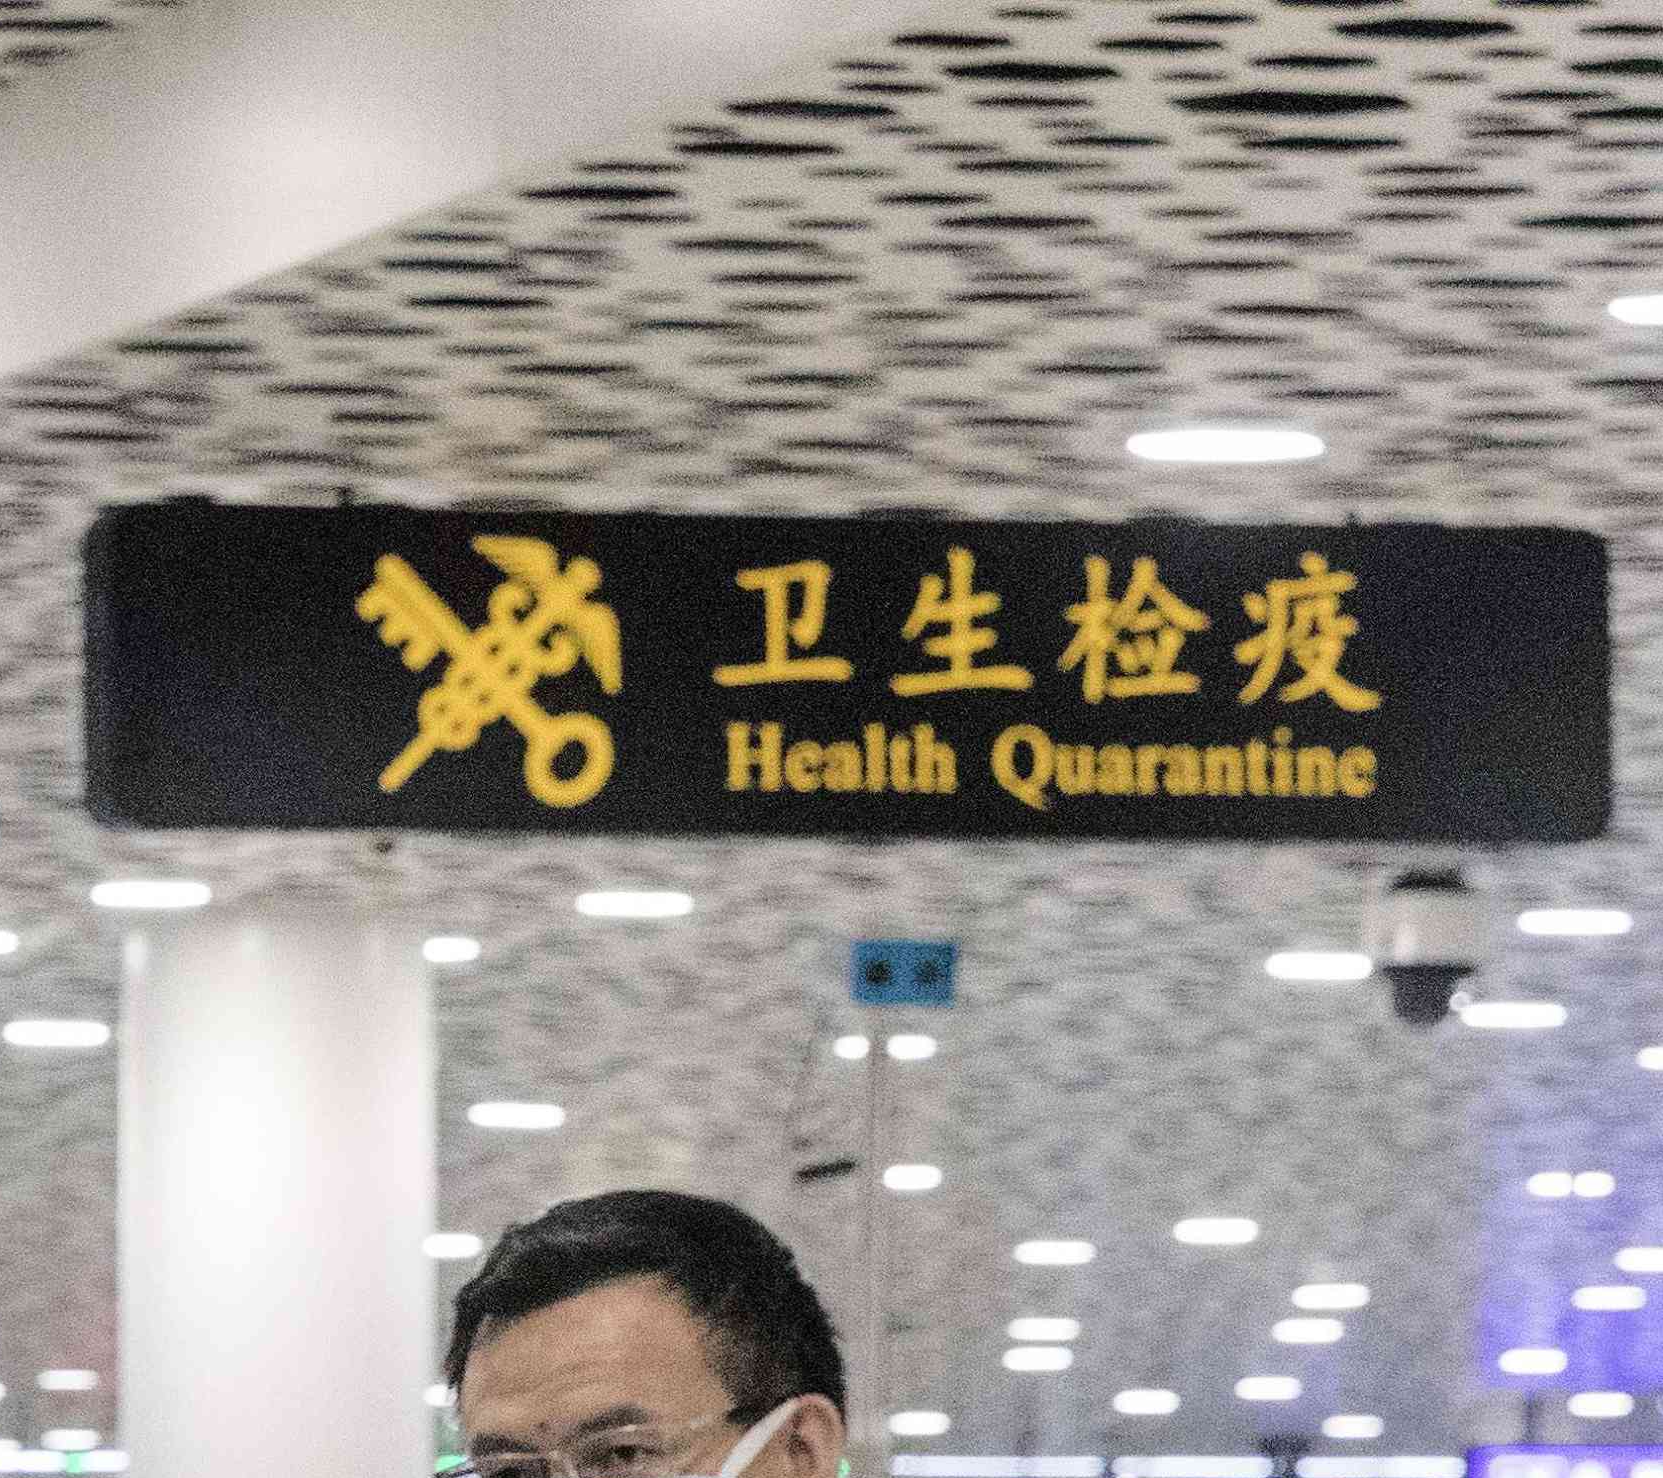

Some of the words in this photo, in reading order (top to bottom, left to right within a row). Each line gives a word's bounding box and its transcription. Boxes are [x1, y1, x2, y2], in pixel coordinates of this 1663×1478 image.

[714, 548, 1380, 713] 卫生检疫
[726, 722, 956, 794] Health
[991, 724, 1376, 810] Quarantine
